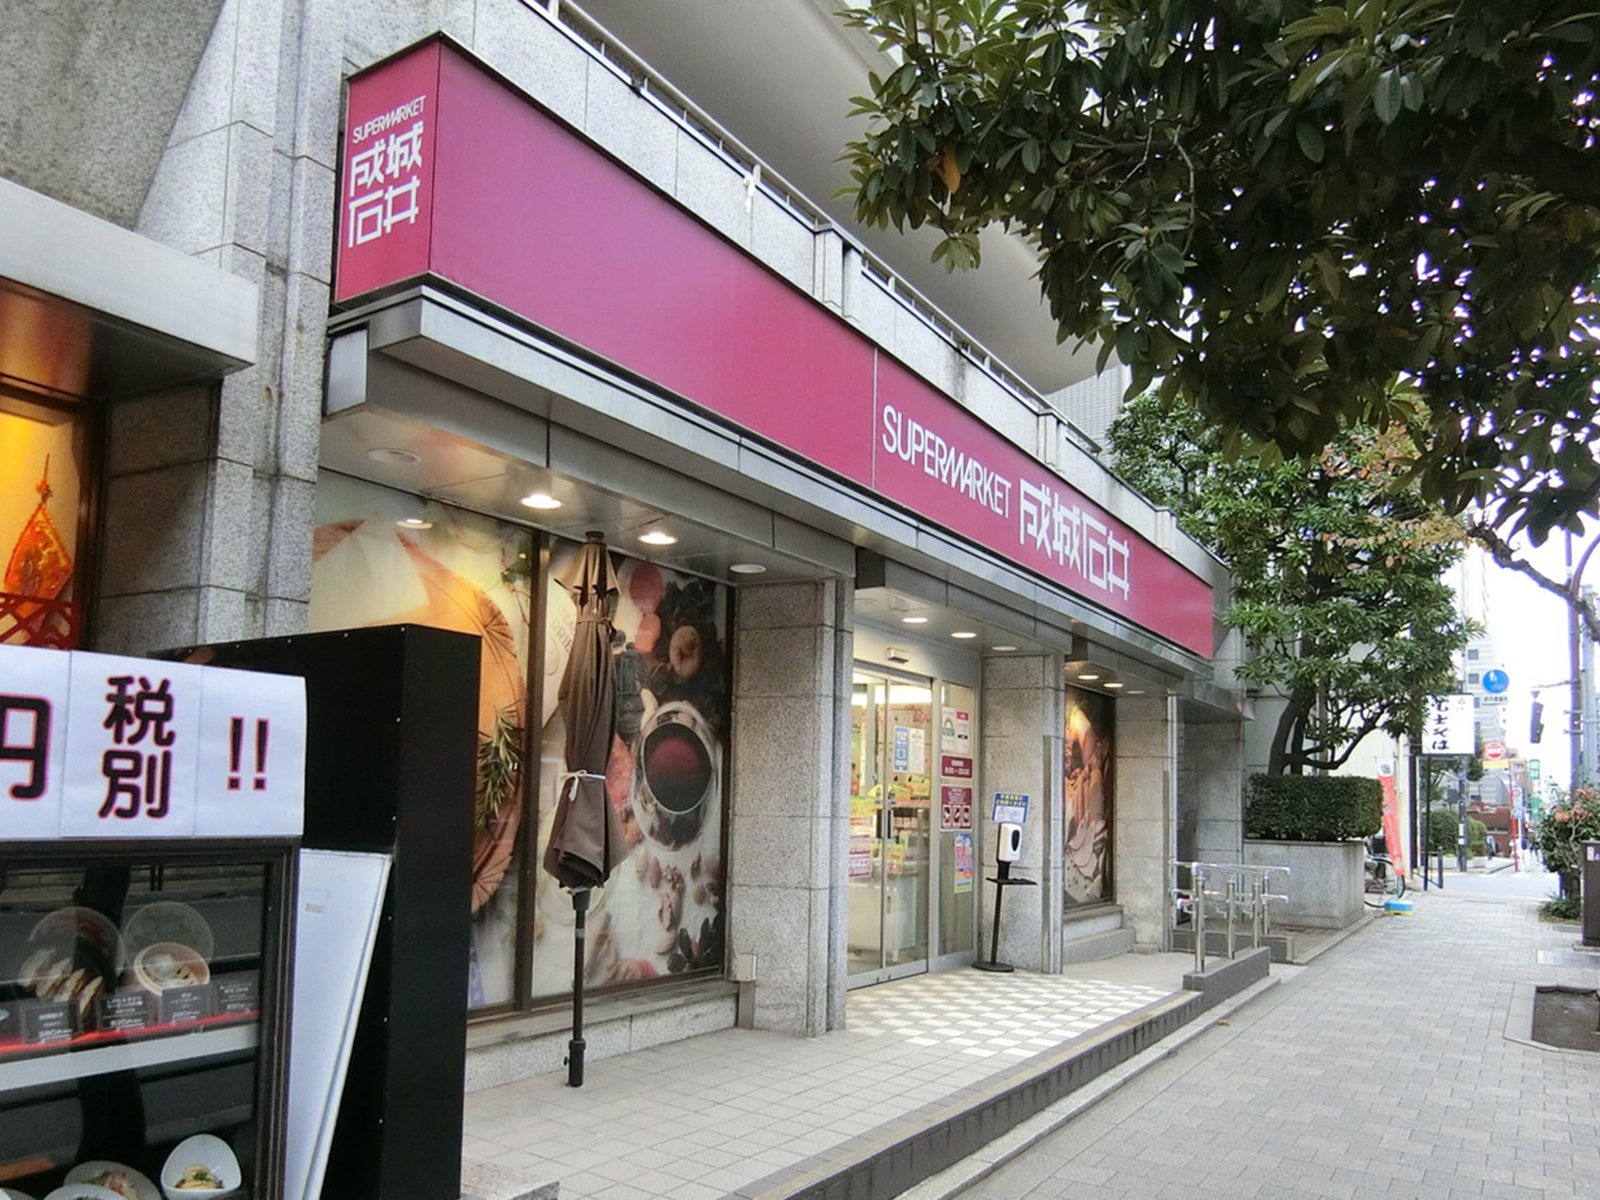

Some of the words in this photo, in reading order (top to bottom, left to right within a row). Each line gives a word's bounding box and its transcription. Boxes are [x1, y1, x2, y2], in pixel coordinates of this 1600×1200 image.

[350, 120, 424, 198] 成城
[352, 95, 426, 145] SUPERMARKET
[348, 176, 421, 249] 石井
[881, 404, 1012, 519] SUPERMARKET
[1018, 477, 1130, 601] 成城石井
[97, 674, 176, 820] 税別
